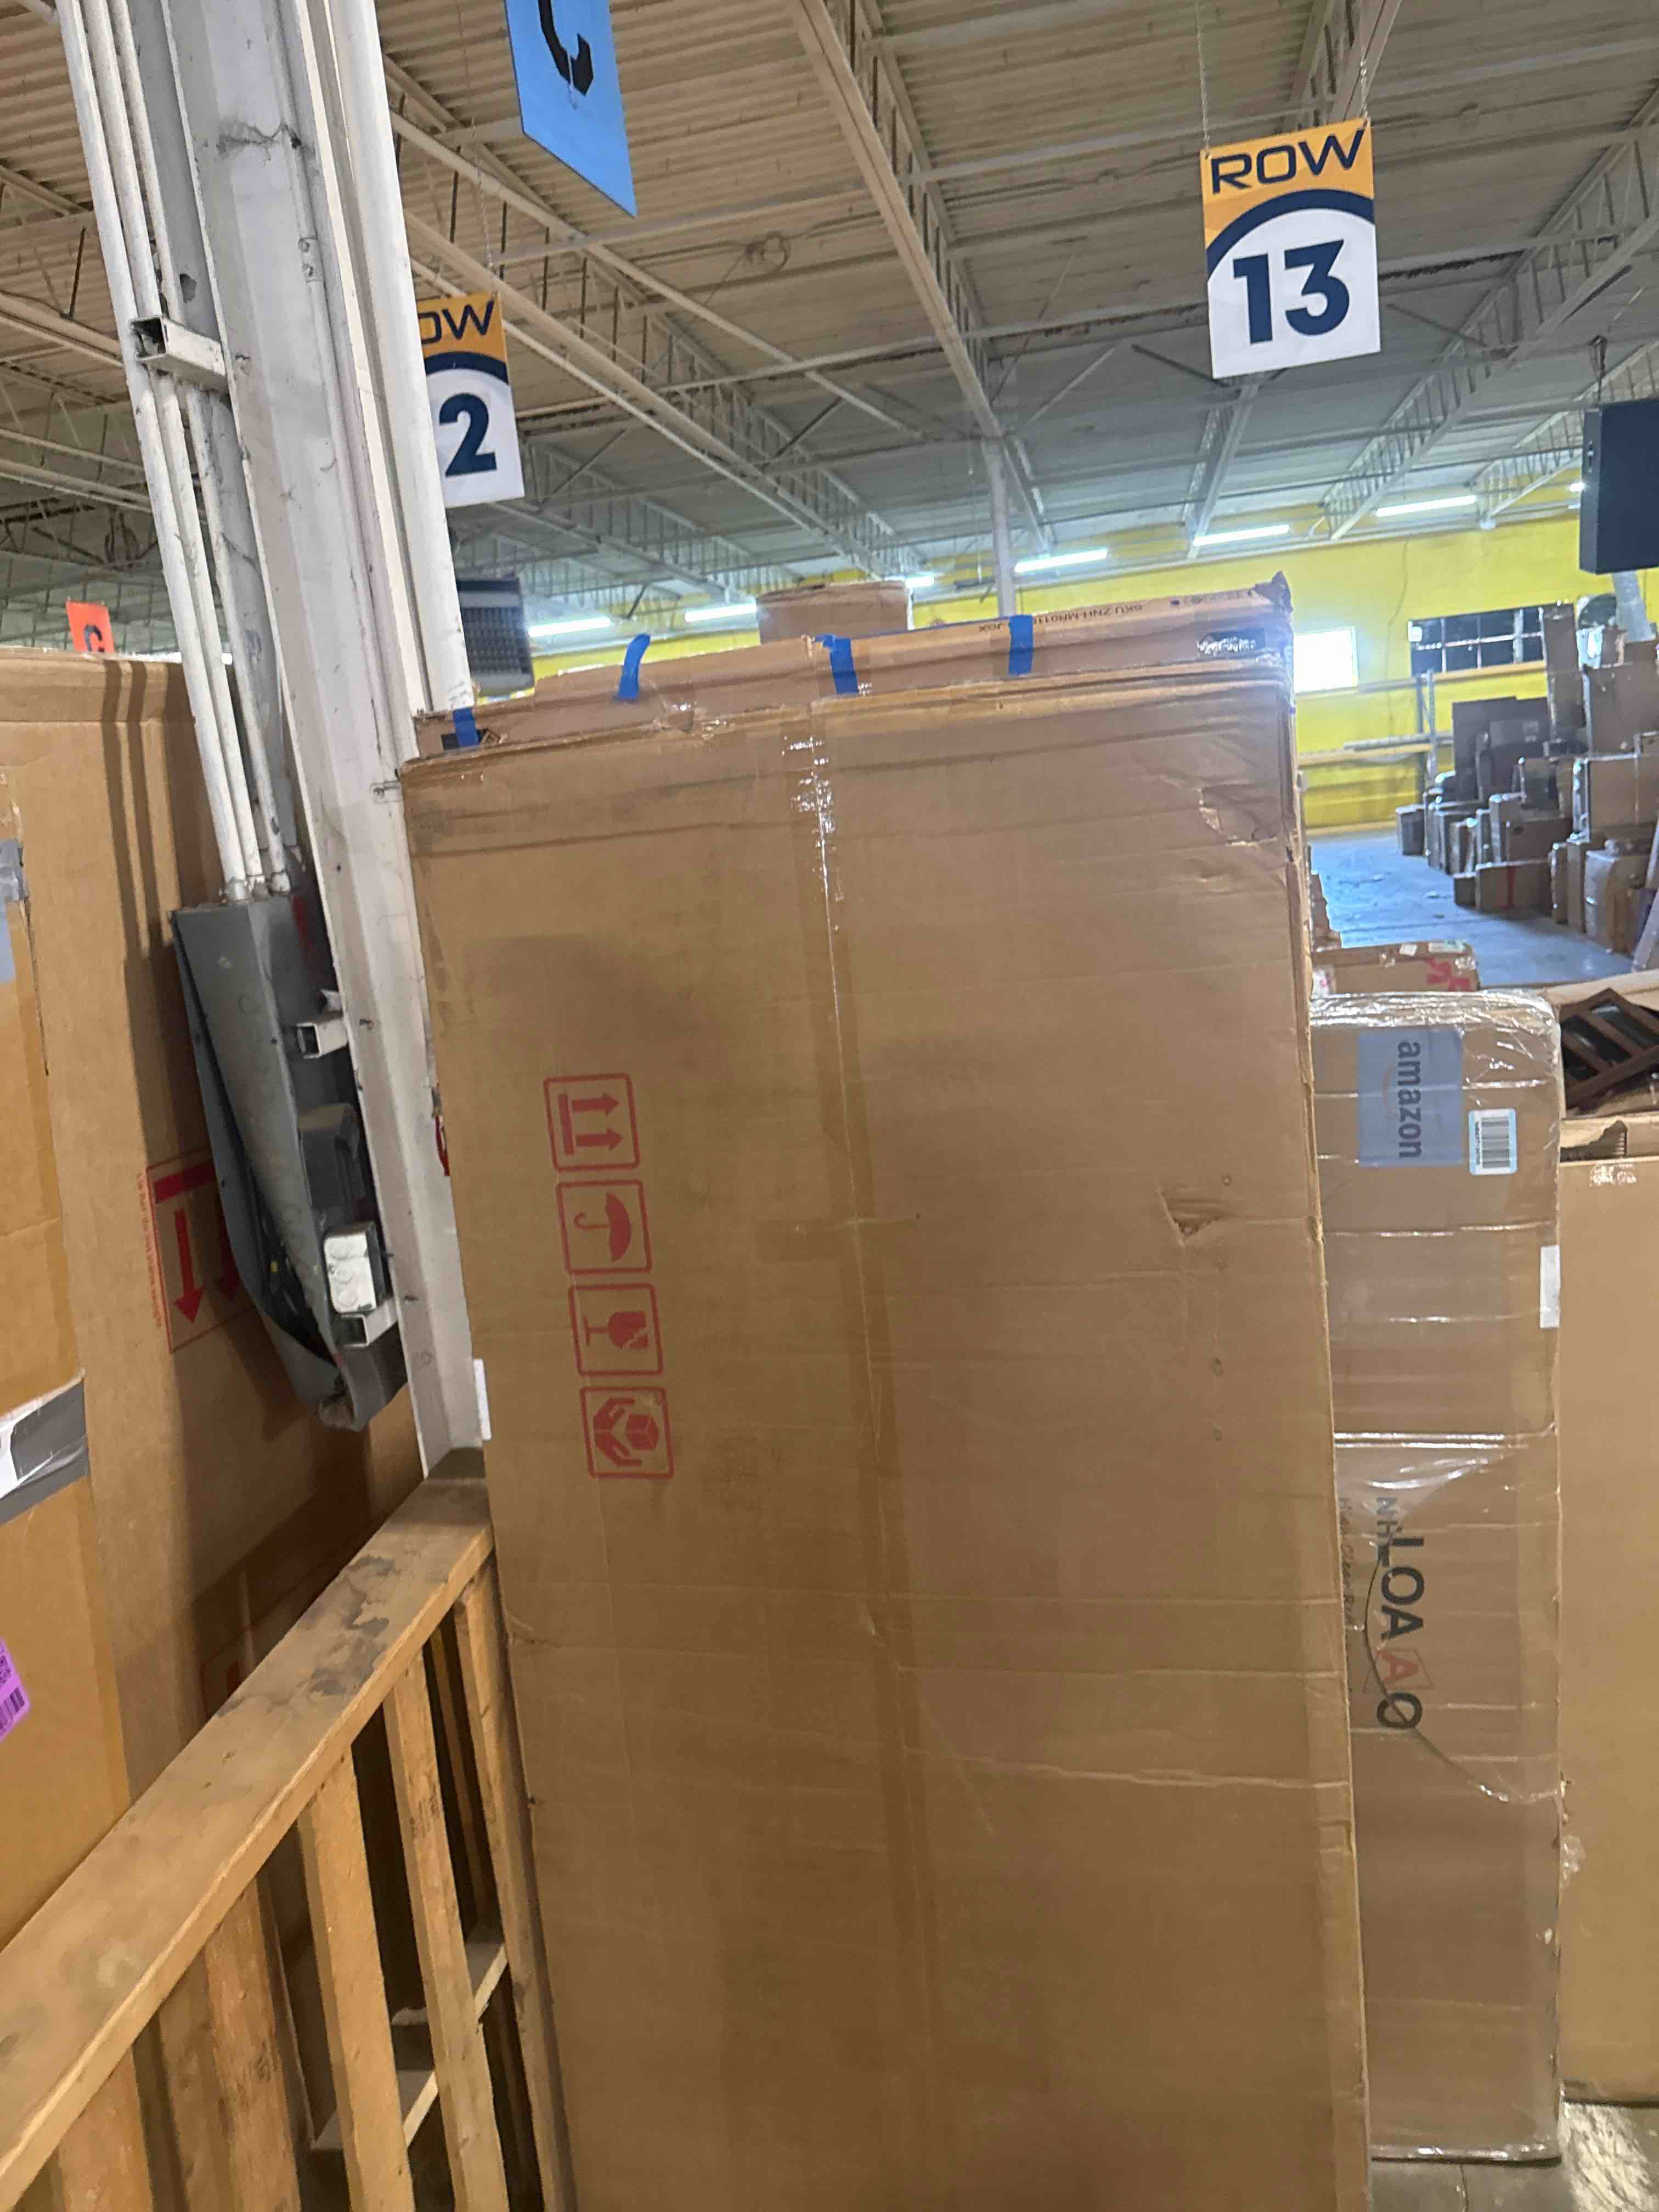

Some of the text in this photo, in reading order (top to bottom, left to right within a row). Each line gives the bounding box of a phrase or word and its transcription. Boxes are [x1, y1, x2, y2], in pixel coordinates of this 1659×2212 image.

[1210, 127, 1365, 194] ROW
[417, 300, 494, 345] OW
[1233, 239, 1350, 345] 13
[439, 393, 497, 477] 2
[1397, 1041, 1422, 1158] amazon
